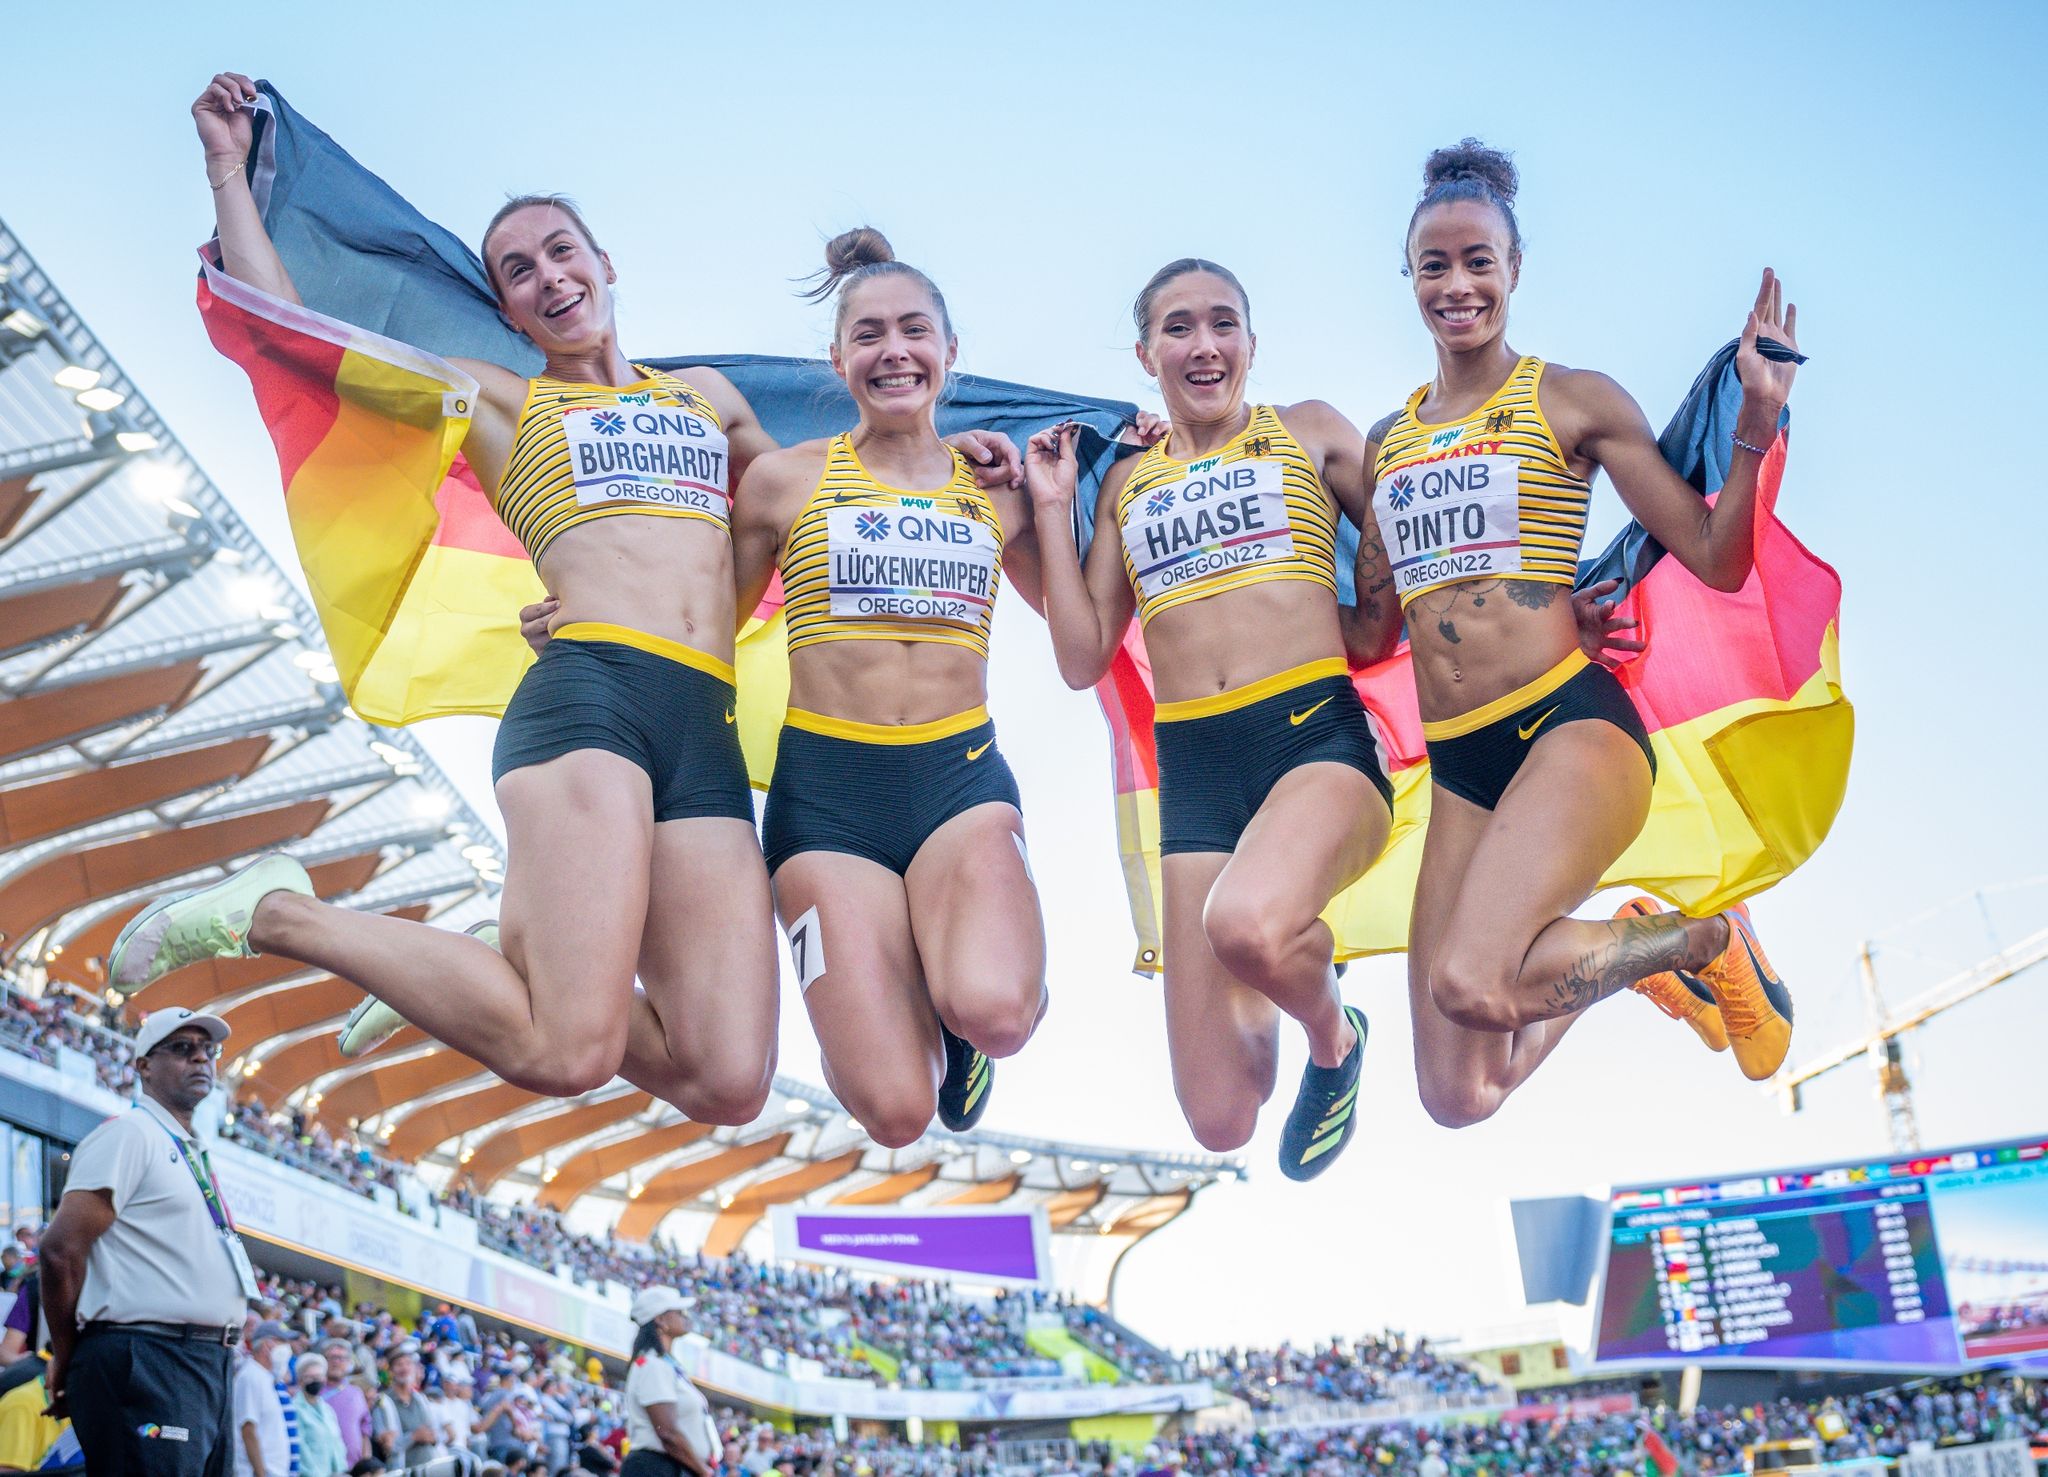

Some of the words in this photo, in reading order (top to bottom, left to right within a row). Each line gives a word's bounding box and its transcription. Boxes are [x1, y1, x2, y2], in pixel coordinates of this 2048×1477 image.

[632, 413, 706, 438] QNB
[578, 441, 723, 485] BURGHARDT
[606, 483, 711, 509] OREGON22
[1182, 468, 1257, 502] QNB
[1421, 463, 1490, 500] QNB
[898, 516, 973, 544] QNB
[1145, 494, 1265, 560] HAASE
[1396, 503, 1485, 555] PINTO
[837, 548, 988, 597] LÜCKENKEMPER
[1161, 544, 1267, 586] OREGON22
[1404, 553, 1492, 587] OREGON22
[858, 597, 967, 618] OREGON22
